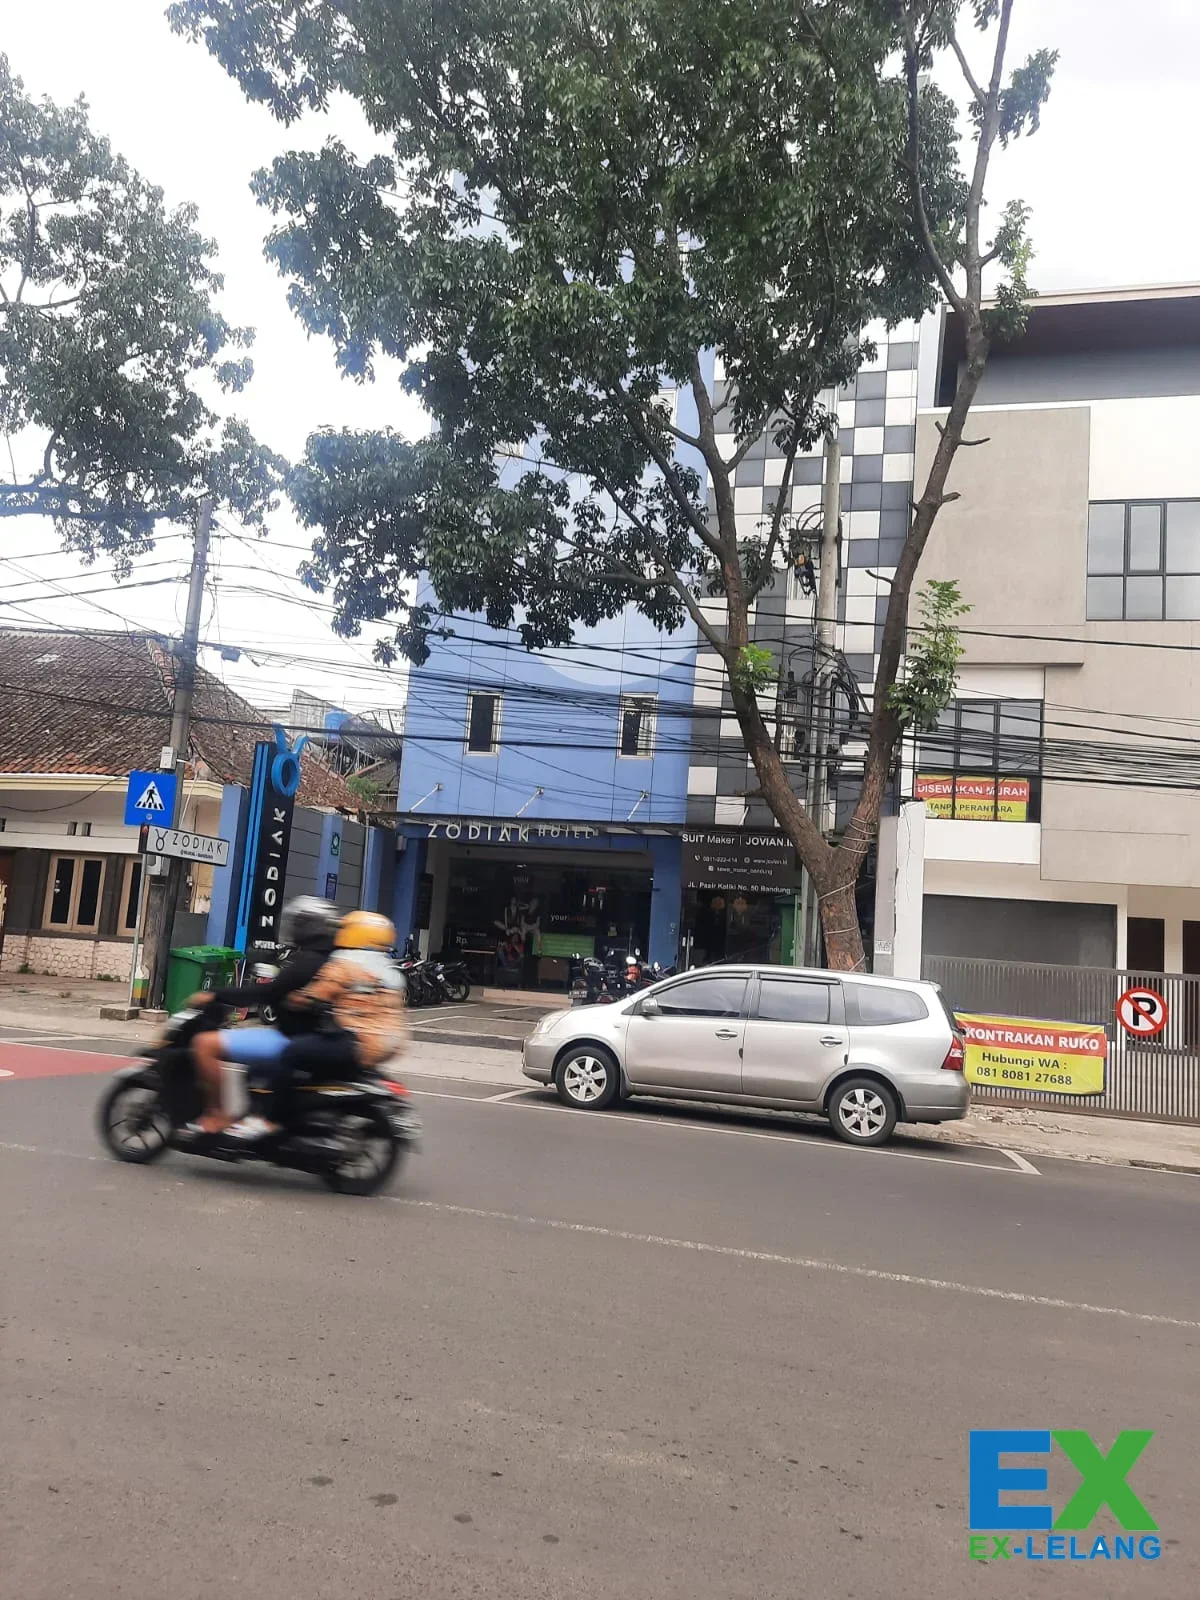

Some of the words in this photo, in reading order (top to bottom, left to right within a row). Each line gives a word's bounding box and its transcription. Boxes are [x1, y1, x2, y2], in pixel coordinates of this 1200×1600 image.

[428, 823, 529, 842] ZODIAK
[538, 826, 592, 839] HOTEL
[682, 833, 705, 843] SUIT
[707, 835, 735, 845] Maker
[172, 832, 222, 854] ZODIAK
[761, 885, 791, 895] Bandung
[963, 1026, 1054, 1048] KONTRAKAN
[1058, 1035, 1100, 1051] RUKO
[982, 1052, 1035, 1069] Hubungi
[1038, 1060, 1060, 1070] WA
[976, 1066, 997, 1077] 081
[1001, 1069, 1031, 1081] 8081
[1034, 1073, 1073, 1085] 27688
